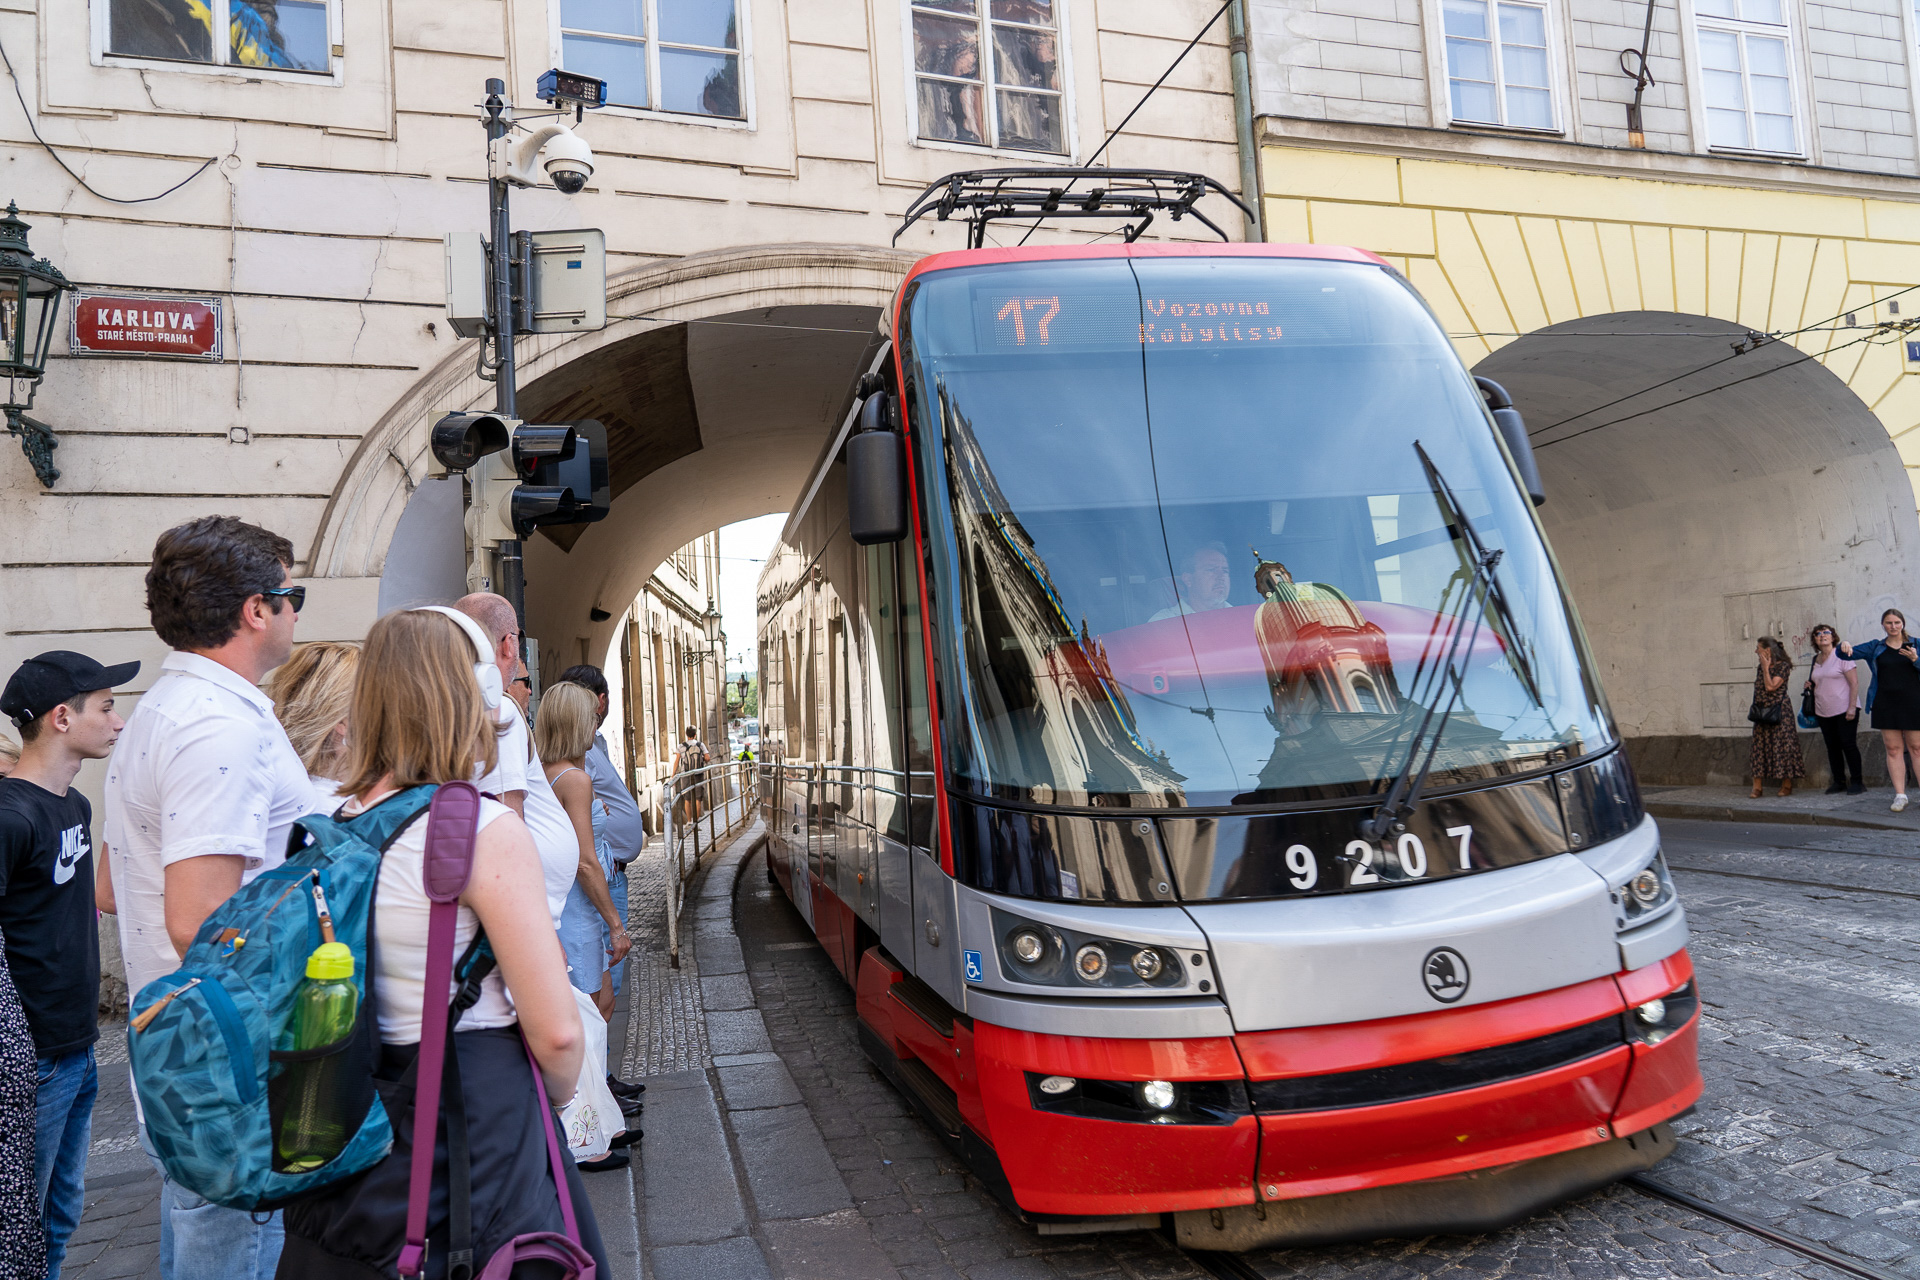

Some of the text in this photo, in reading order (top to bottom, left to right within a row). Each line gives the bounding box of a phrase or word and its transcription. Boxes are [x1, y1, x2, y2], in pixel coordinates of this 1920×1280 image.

[1146, 299, 1270, 316] Vozovna
[97, 308, 195, 330] KARLOVA
[997, 296, 1060, 345] 17
[97, 328, 124, 341] STARÉ
[189, 334, 194, 344] 1
[1138, 322, 1284, 344] Kobylisy
[61, 823, 85, 860] NIKE
[1285, 824, 1473, 890] 9207
